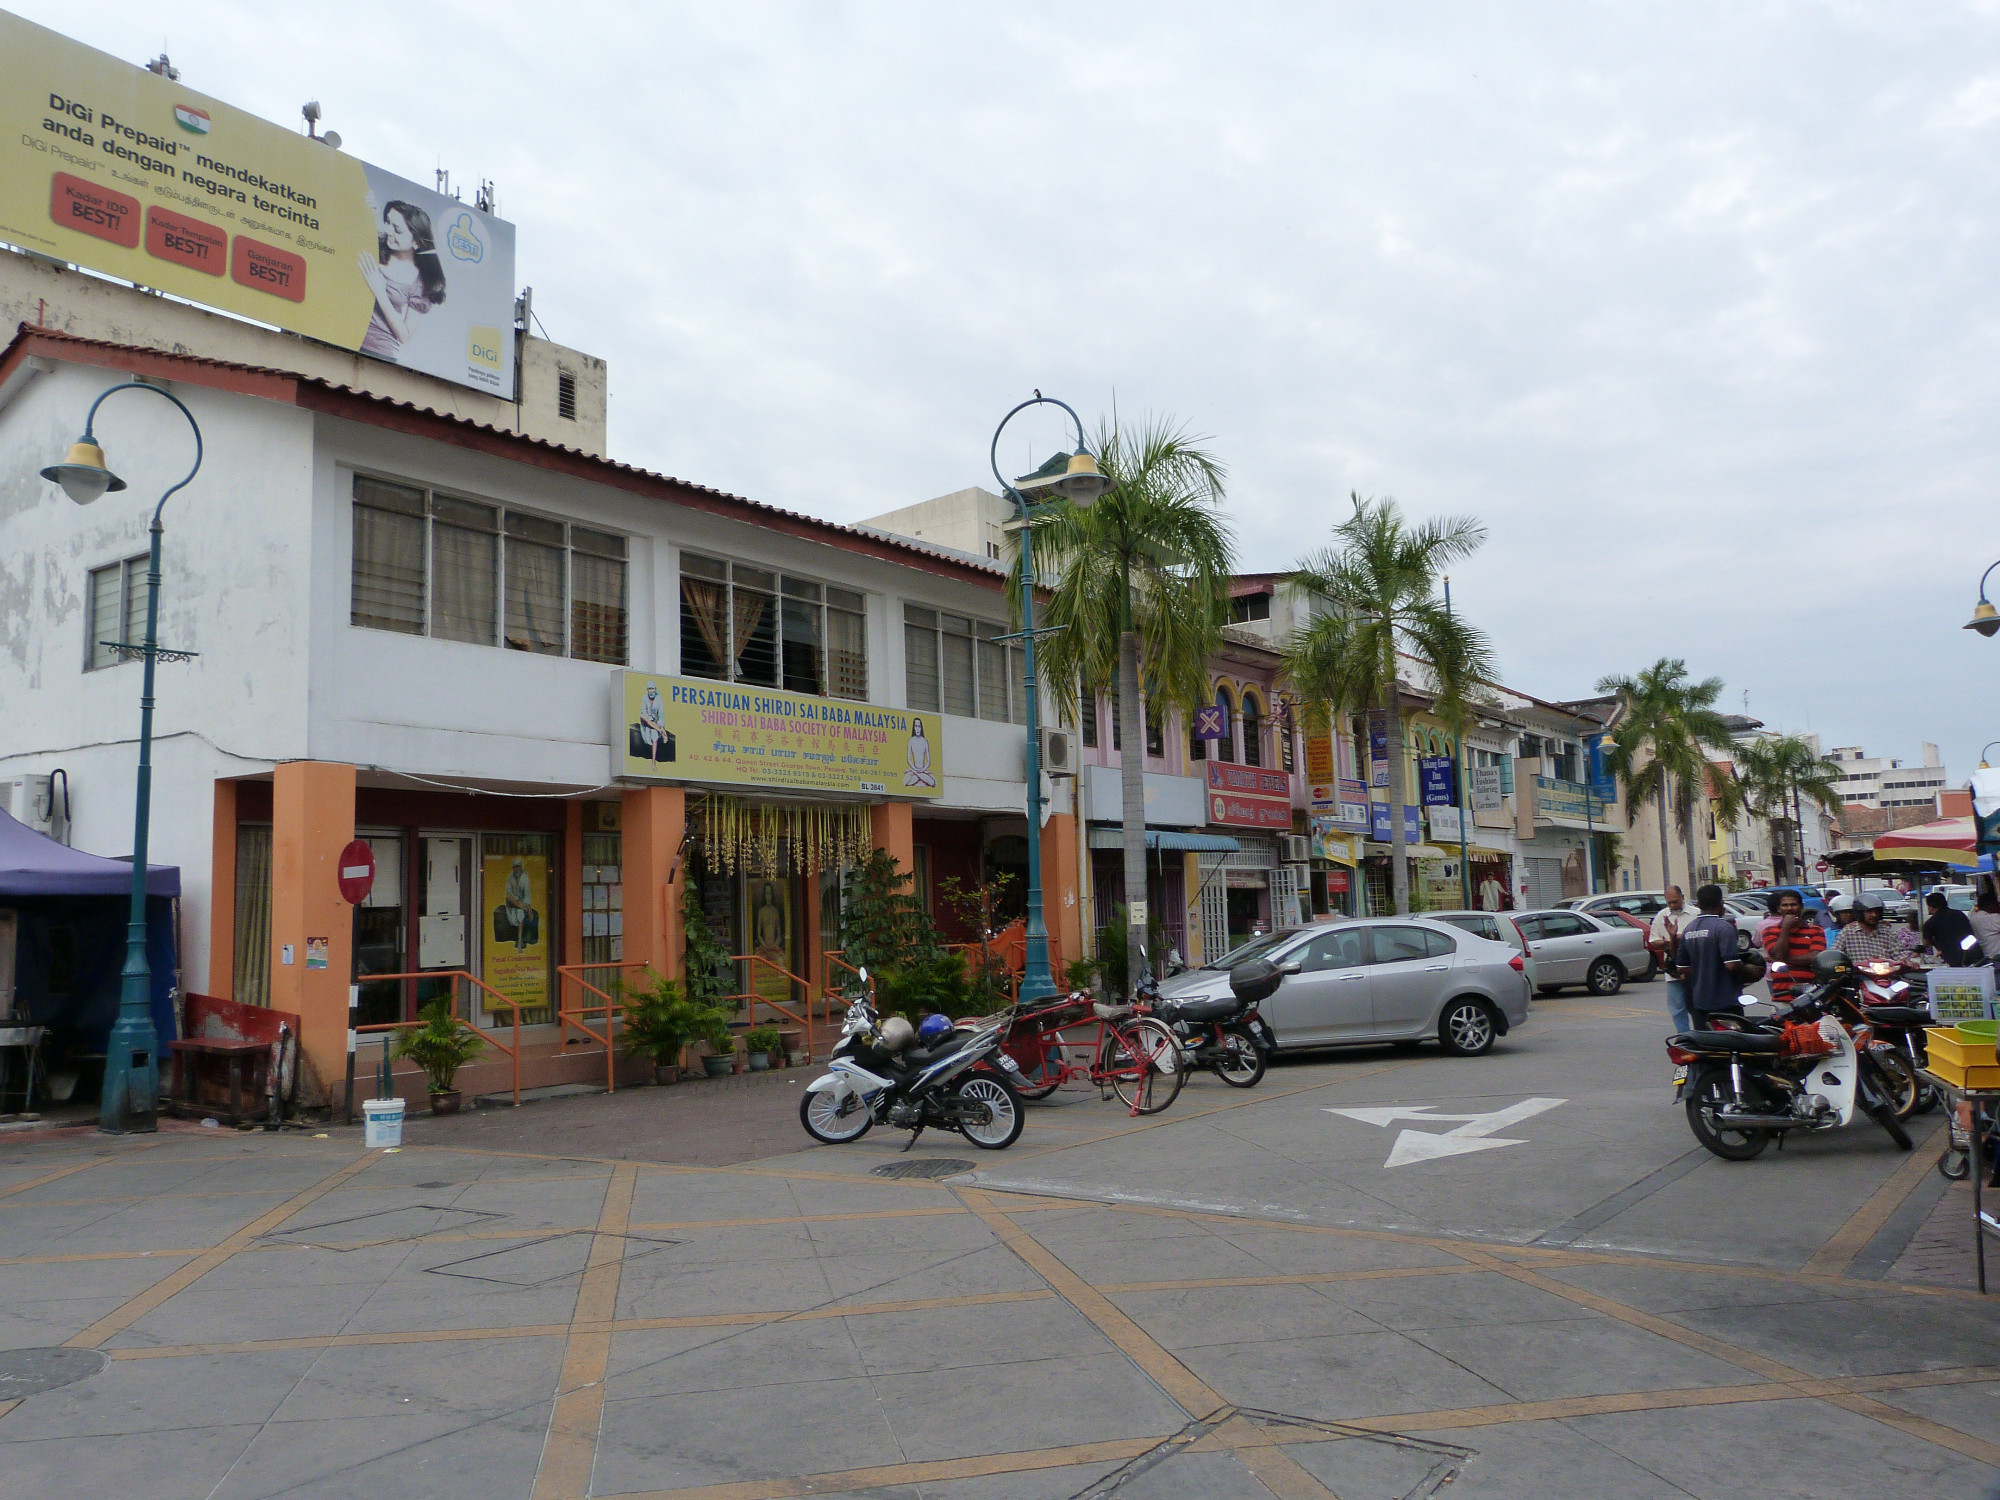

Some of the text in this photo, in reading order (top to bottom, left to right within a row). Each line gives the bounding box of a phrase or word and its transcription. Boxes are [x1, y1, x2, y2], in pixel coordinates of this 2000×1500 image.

[22, 134, 48, 152] DiGi
[50, 93, 93, 123] DiGi
[196, 154, 317, 209] mendekatkan
[43, 118, 319, 230] anda dengan negara tercinta
[66, 186, 128, 215] Kadar IDD
[72, 201, 120, 231] BEST!
[151, 217, 223, 247] Kadar Tempatan
[164, 233, 209, 259] BEST!
[247, 250, 293, 272] Ganjaran
[250, 262, 290, 287] BEST!
[472, 344, 497, 362] DiGi
[672, 685, 907, 731] PERSATUAN SHIRDI SAI BABA MALAYSIA
[701, 709, 887, 743] SHIRDI SAI BABA SOCIETY OF MALAYSIA
[736, 758, 758, 766] Queen
[759, 760, 779, 768] Street
[781, 762, 803, 771] George
[771, 749, 797, 758] பாபா
[1476, 777, 1497, 785] Fashion
[1426, 794, 1450, 802] (Gems)
